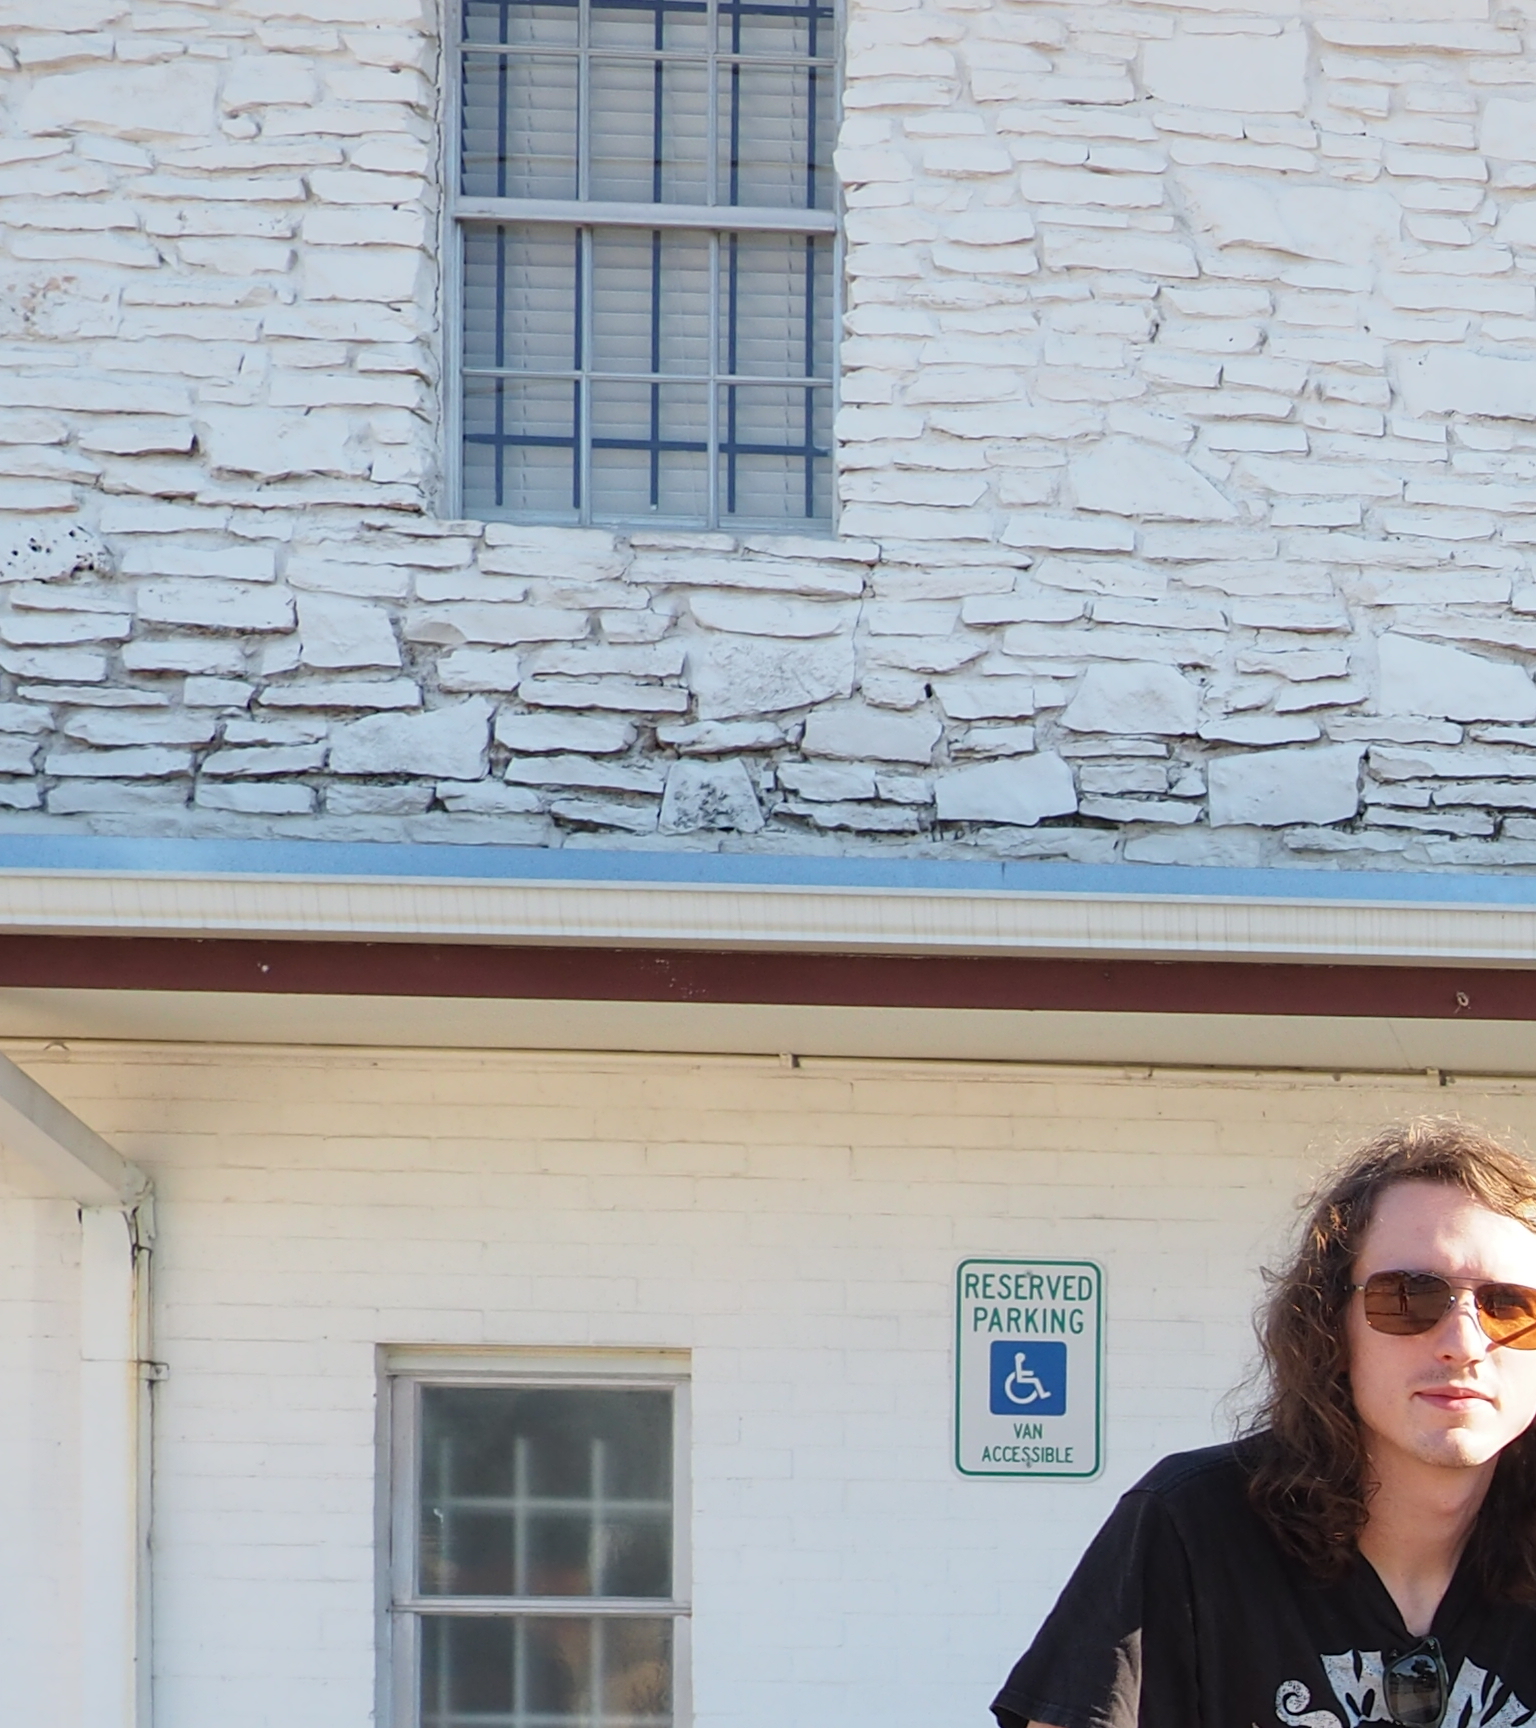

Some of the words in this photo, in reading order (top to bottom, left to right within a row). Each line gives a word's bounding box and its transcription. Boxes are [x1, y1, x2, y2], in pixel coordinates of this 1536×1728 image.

[964, 1273, 1093, 1301] RESERVED
[973, 1306, 1084, 1335] PARKING
[1013, 1422, 1043, 1440] VAN
[981, 1445, 1074, 1463] ACCESSIBLE
